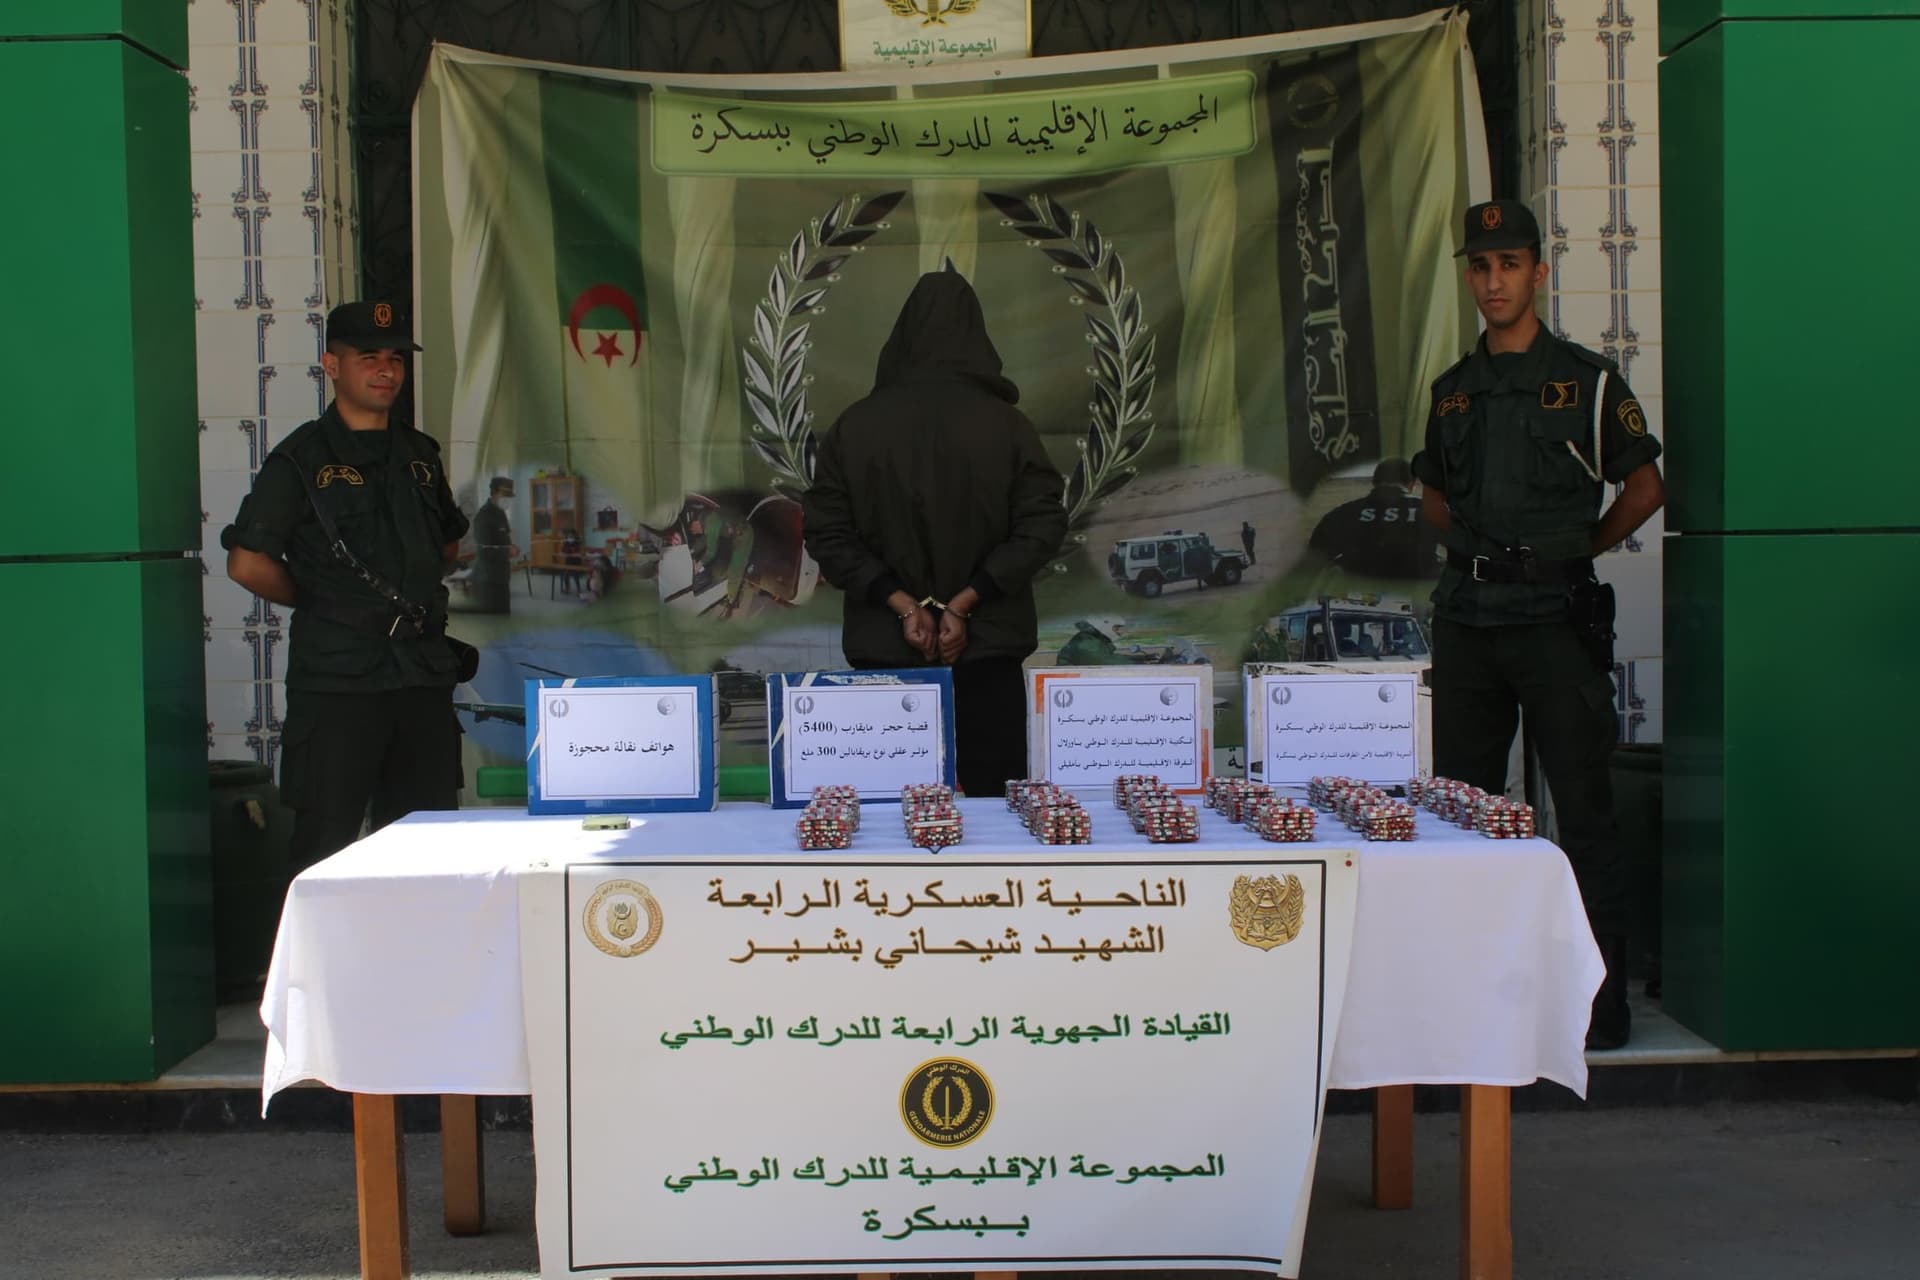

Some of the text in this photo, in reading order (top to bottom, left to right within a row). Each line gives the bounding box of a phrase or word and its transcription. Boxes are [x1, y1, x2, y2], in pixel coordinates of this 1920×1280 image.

[873, 37, 997, 68] المجموعة الإقليمية
[691, 94, 1218, 163] المجموعة الإقليمية للدرك الوطني ببسكرة
[1087, 714, 1108, 725] الوطني
[1110, 713, 1128, 724] للدرك
[1160, 713, 1193, 724] المجموعة
[798, 721, 928, 736] قضية حجز مايقارب (5400)
[1305, 723, 1326, 734] الوطني
[1328, 723, 1347, 733] للدرك
[1379, 722, 1412, 733] المجموعة
[568, 740, 674, 757] هواتف نقالة محجوزة
[1085, 738, 1109, 750] الوطني
[1111, 738, 1133, 749] للدرك
[817, 747, 837, 756] 300
[873, 747, 885, 760] نوع
[888, 746, 907, 758] عقلي
[1083, 760, 1112, 770] الوطني
[1114, 759, 1136, 769] للدرك
[707, 877, 1187, 917] الناحية العسكرية الرابعة
[729, 925, 1164, 969] الشهيد شيحاني بشير
[659, 1012, 1231, 1050] القيادة الجهوية الرابعة للدرك الوطني
[909, 1110, 986, 1142] GENDARMERIE NATIONALE
[663, 1153, 1225, 1193] المجموعة الإقليمية للدرك الوطني
[861, 1205, 1030, 1240] ببسكرة
